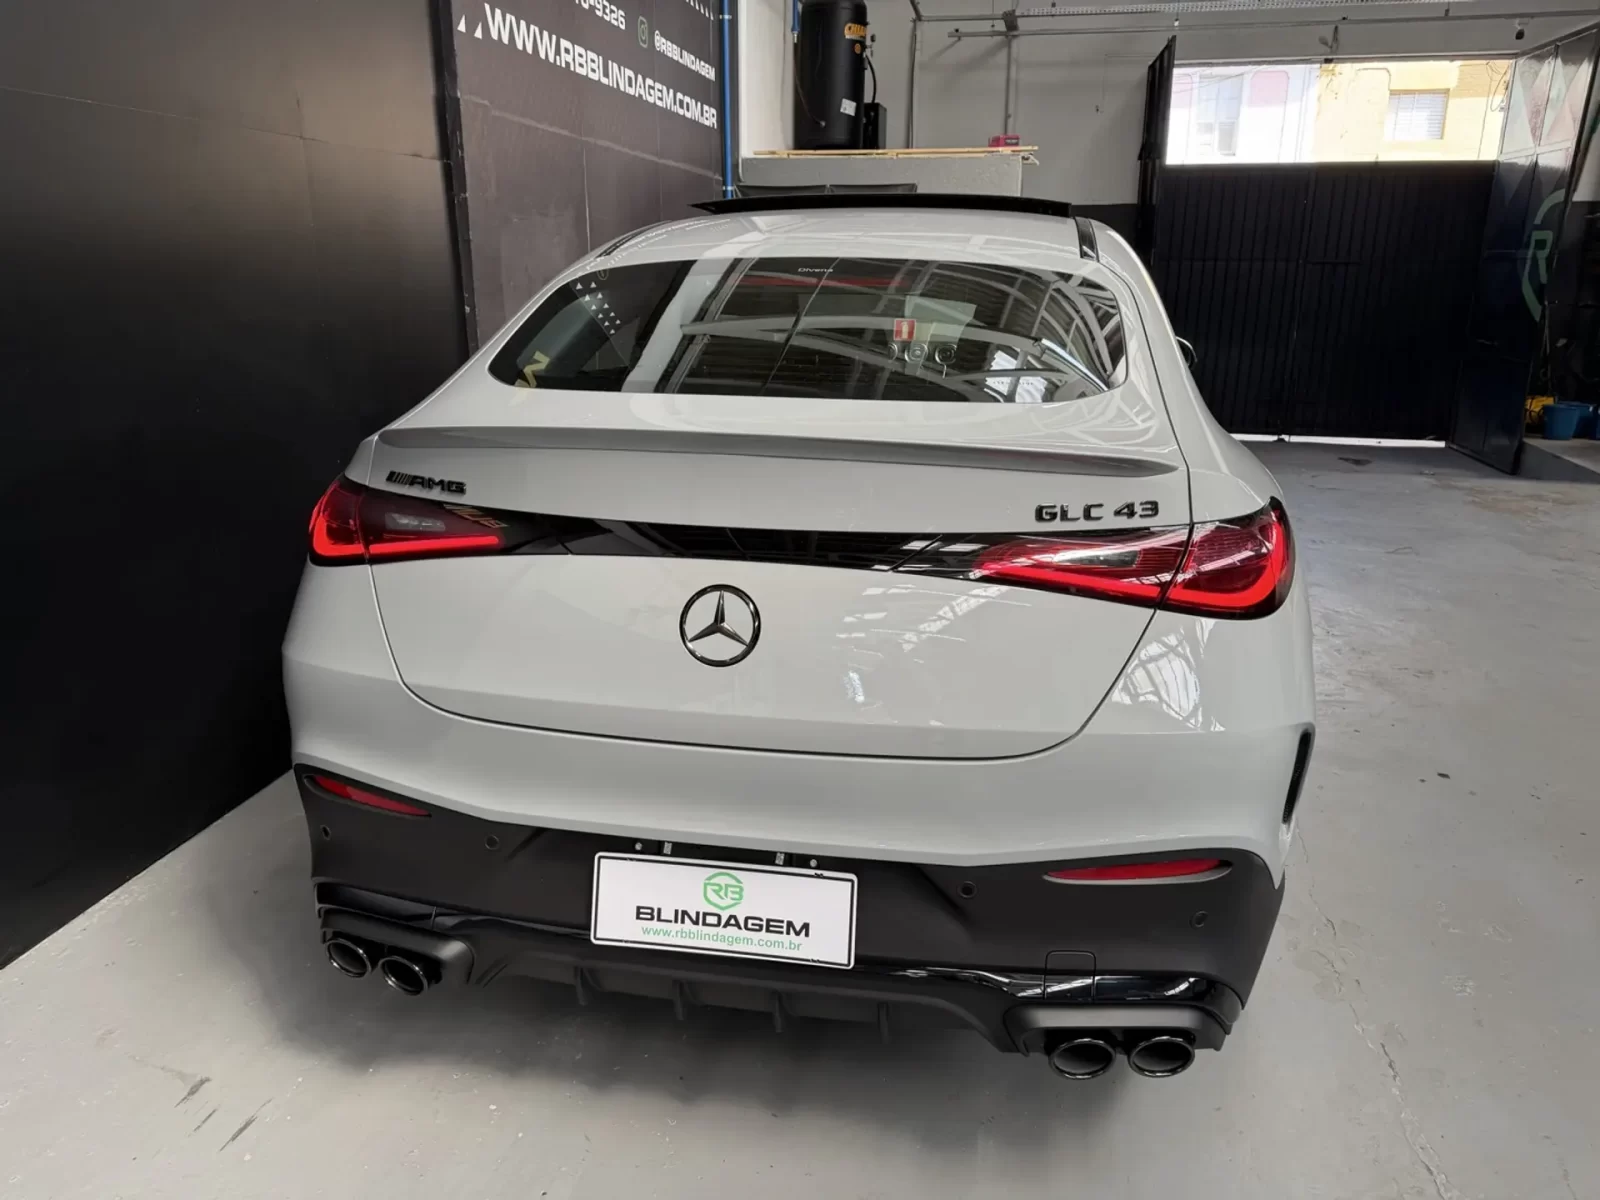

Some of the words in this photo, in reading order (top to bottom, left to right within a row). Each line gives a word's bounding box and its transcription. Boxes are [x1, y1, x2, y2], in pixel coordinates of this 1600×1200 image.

[575, 0, 626, 30] -9326
[484, 2, 717, 129] WWW.RBBLINDAGEM.COM.BR
[654, 30, 715, 82] @RBBLINDAGEM
[408, 474, 467, 495] AMG
[1035, 503, 1104, 523] GLC
[1113, 500, 1159, 519] 43
[635, 905, 811, 938] BLINDAGEM
[641, 926, 803, 951] www.rbblindagem.com.br
